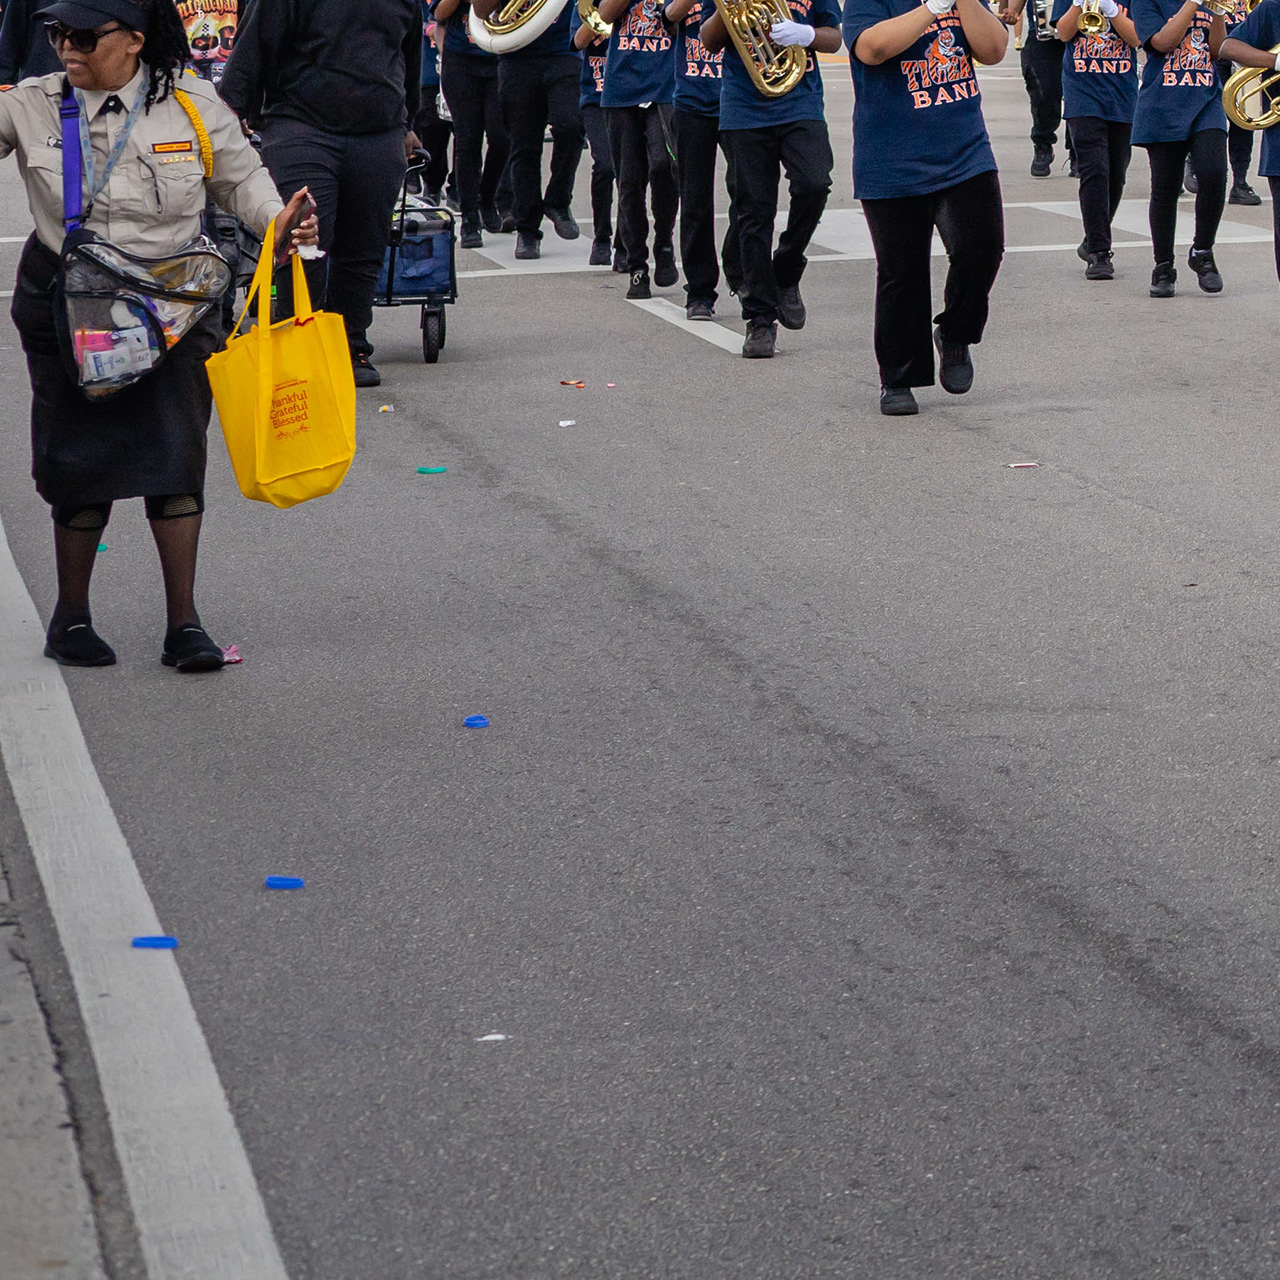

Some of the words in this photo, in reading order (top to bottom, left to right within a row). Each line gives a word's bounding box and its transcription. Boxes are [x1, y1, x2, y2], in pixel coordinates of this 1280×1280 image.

[940, 18, 961, 28] SCH
[1222, 12, 1246, 25] AN
[617, 37, 672, 53] BAND
[1073, 36, 1131, 59] TIGER
[685, 62, 723, 79] BA
[900, 54, 973, 92] TIGER
[1074, 59, 1131, 74] BAND
[272, 389, 308, 409] hankful
[269, 400, 309, 420] Grateful
[271, 411, 309, 429] Blessed
